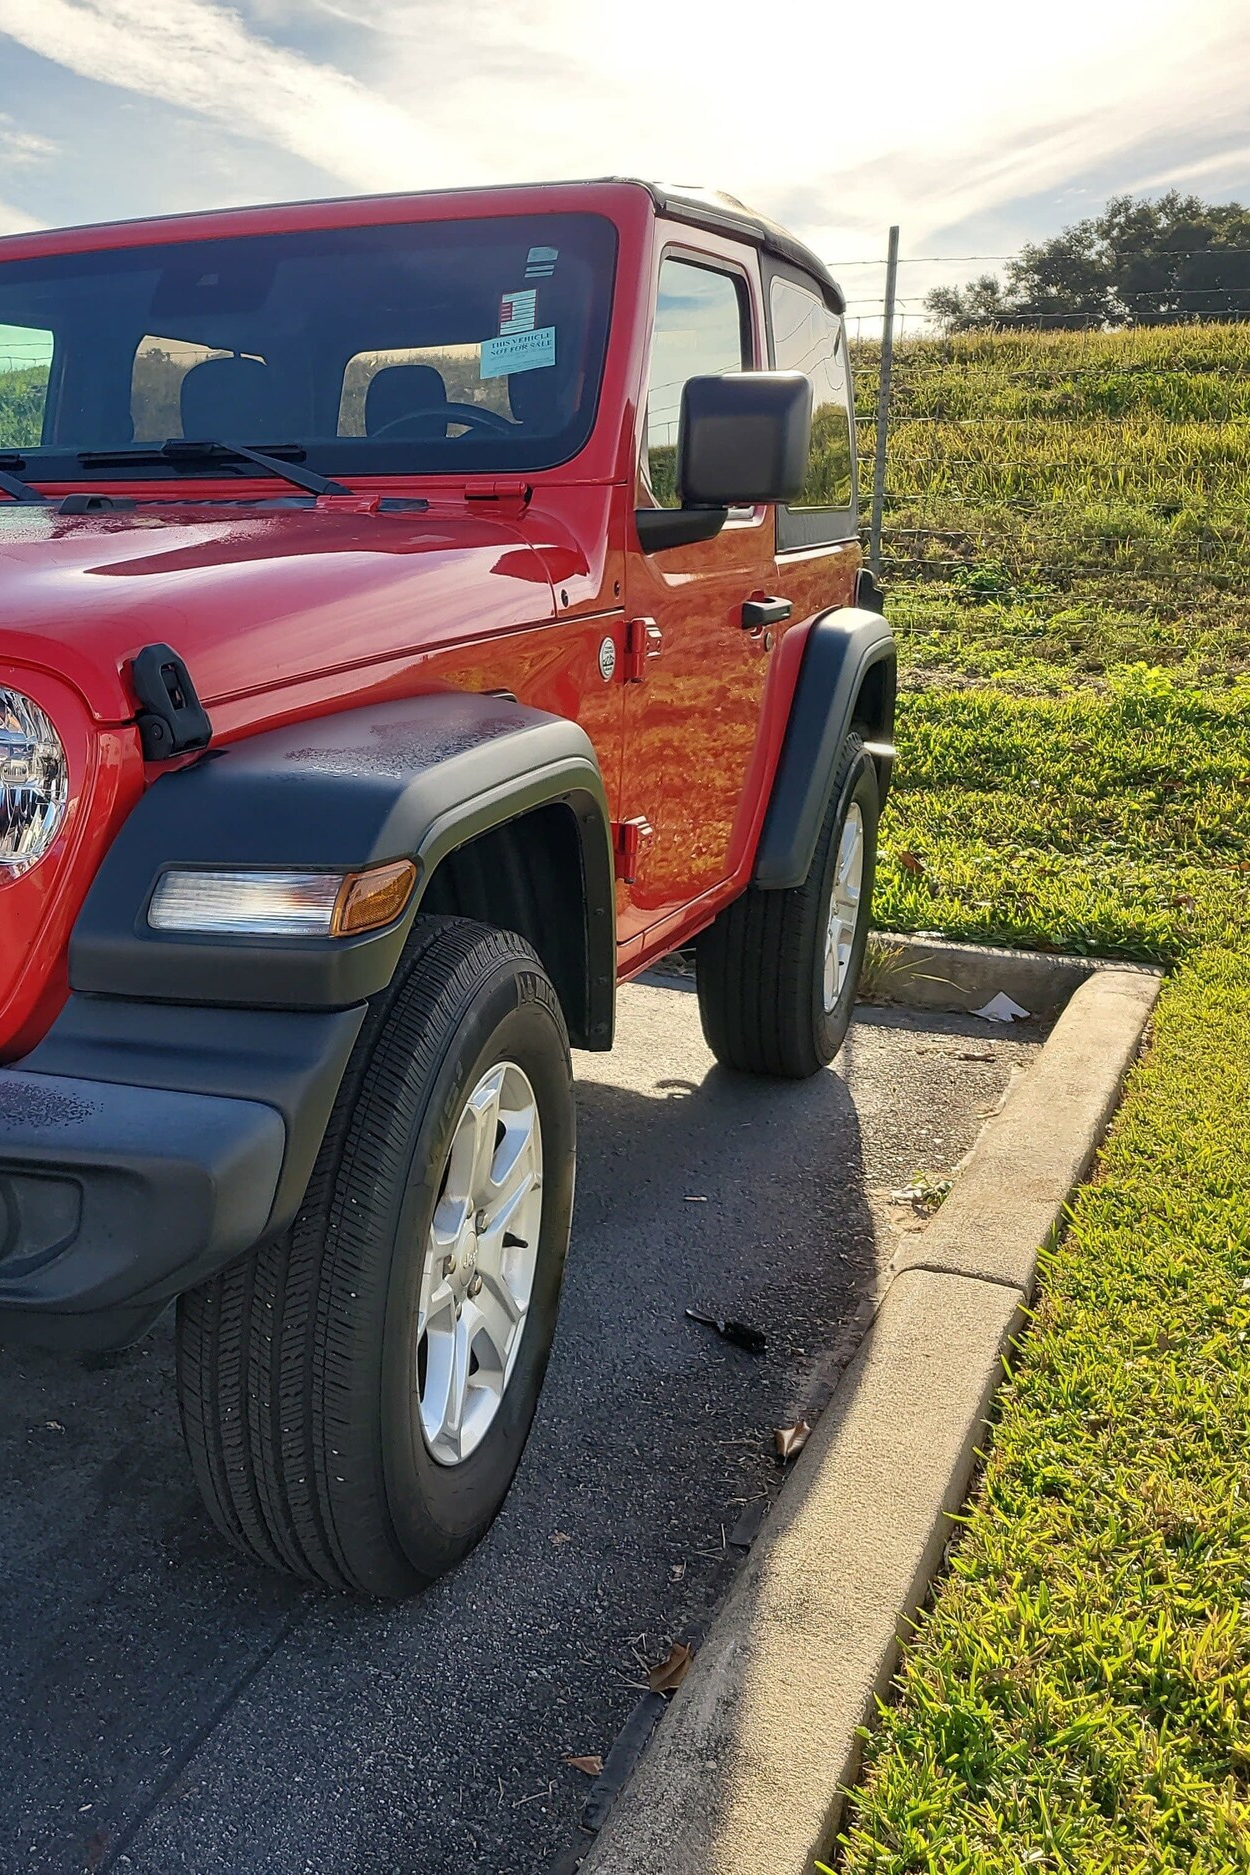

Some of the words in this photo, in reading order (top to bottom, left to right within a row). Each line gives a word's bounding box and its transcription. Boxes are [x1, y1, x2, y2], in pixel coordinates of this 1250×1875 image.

[492, 340, 511, 349] THIS
[512, 332, 551, 344] VEHICLE
[510, 343, 529, 352] FOR
